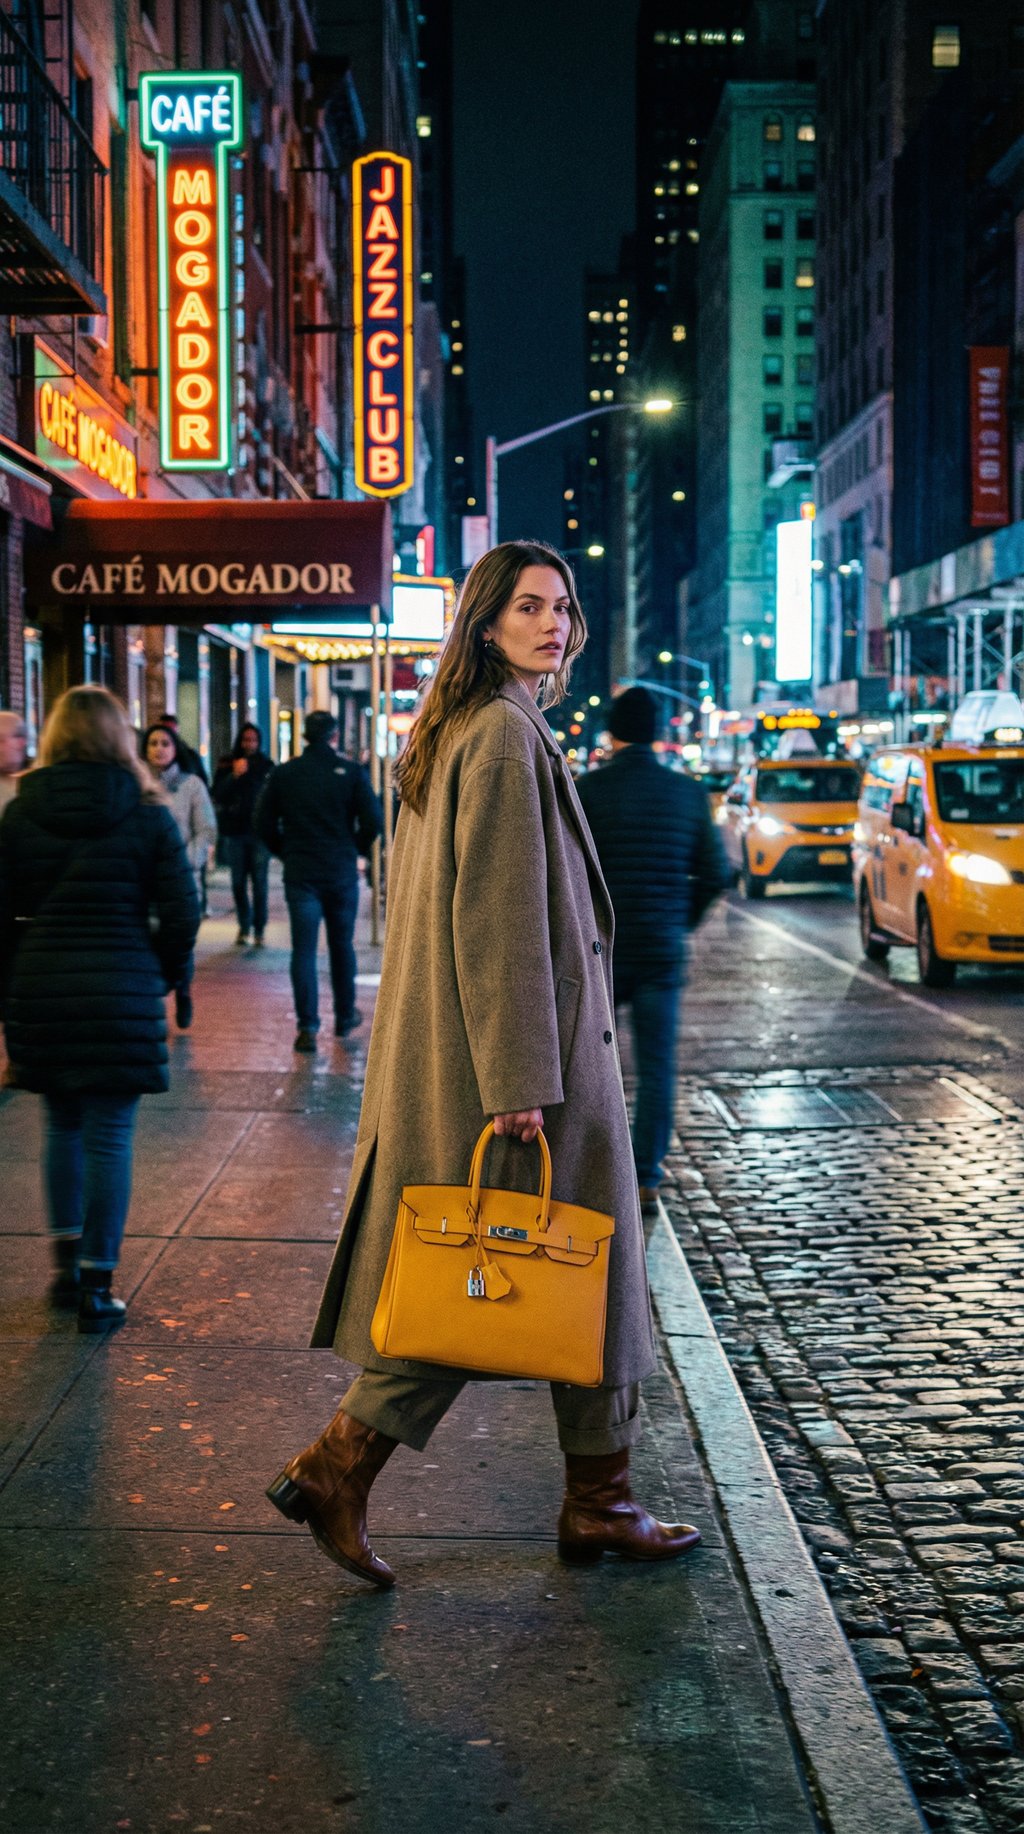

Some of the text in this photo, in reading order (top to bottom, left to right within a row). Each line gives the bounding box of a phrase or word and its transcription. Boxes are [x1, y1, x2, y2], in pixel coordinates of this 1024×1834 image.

[151, 86, 232, 132] CAFÉ
[173, 169, 213, 450] MOGADOR
[365, 166, 400, 482] JAZZ CLUB
[40, 382, 78, 457] CAFÉ
[51, 555, 355, 594] CAFÉ MOGADOR
